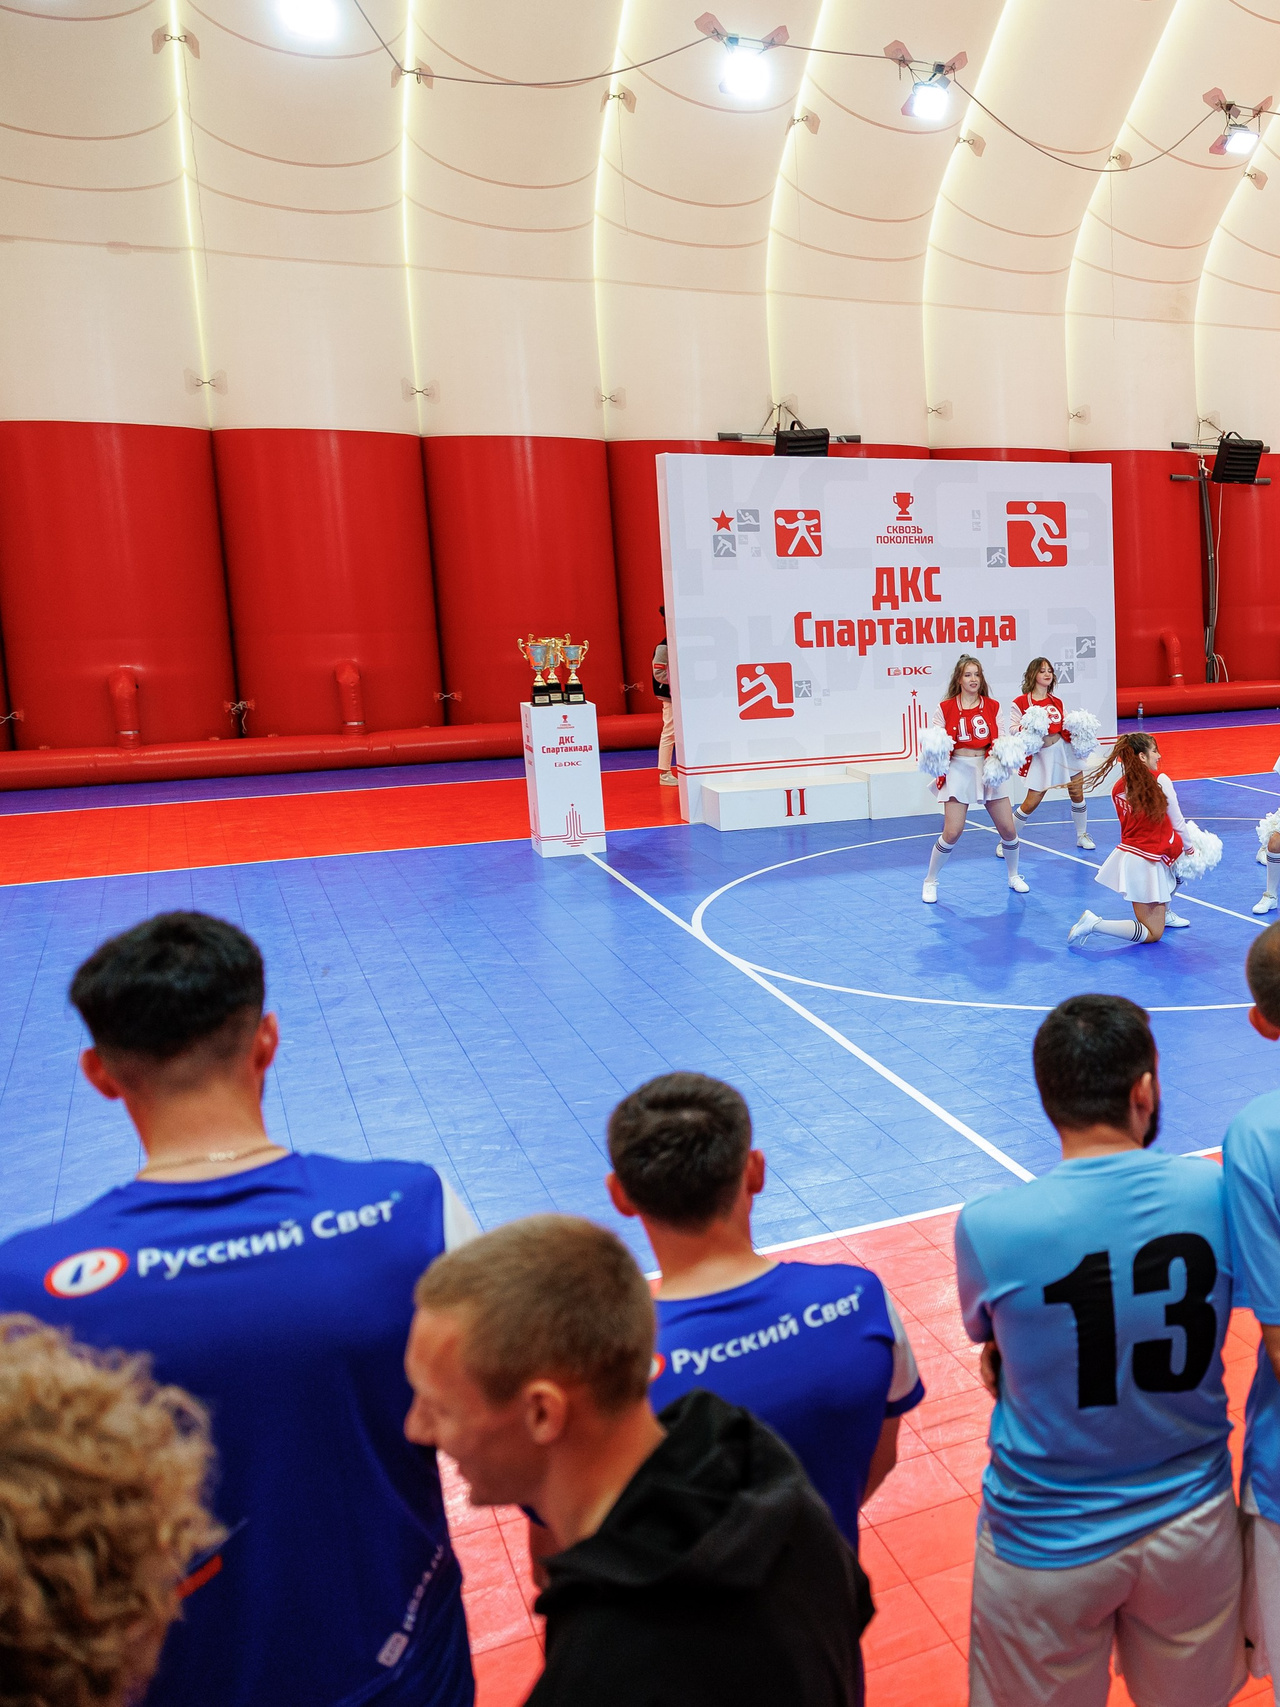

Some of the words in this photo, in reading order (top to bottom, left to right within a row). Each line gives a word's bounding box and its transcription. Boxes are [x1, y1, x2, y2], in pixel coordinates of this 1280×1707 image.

[876, 535, 934, 544] ПОКОЛЕНИЯ
[886, 525, 923, 535] СКВОЗЬ
[872, 566, 942, 611] ДКС
[793, 611, 1017, 656] Спартакиада
[902, 666, 932, 676] DKC
[559, 735, 575, 745] ДКС
[957, 714, 990, 742] 18
[541, 745, 593, 755] Спартакиада
[784, 788, 808, 817] II
[137, 1218, 304, 1280] Русский
[1043, 1232, 1218, 1410] 13
[670, 1313, 800, 1376] Русский
